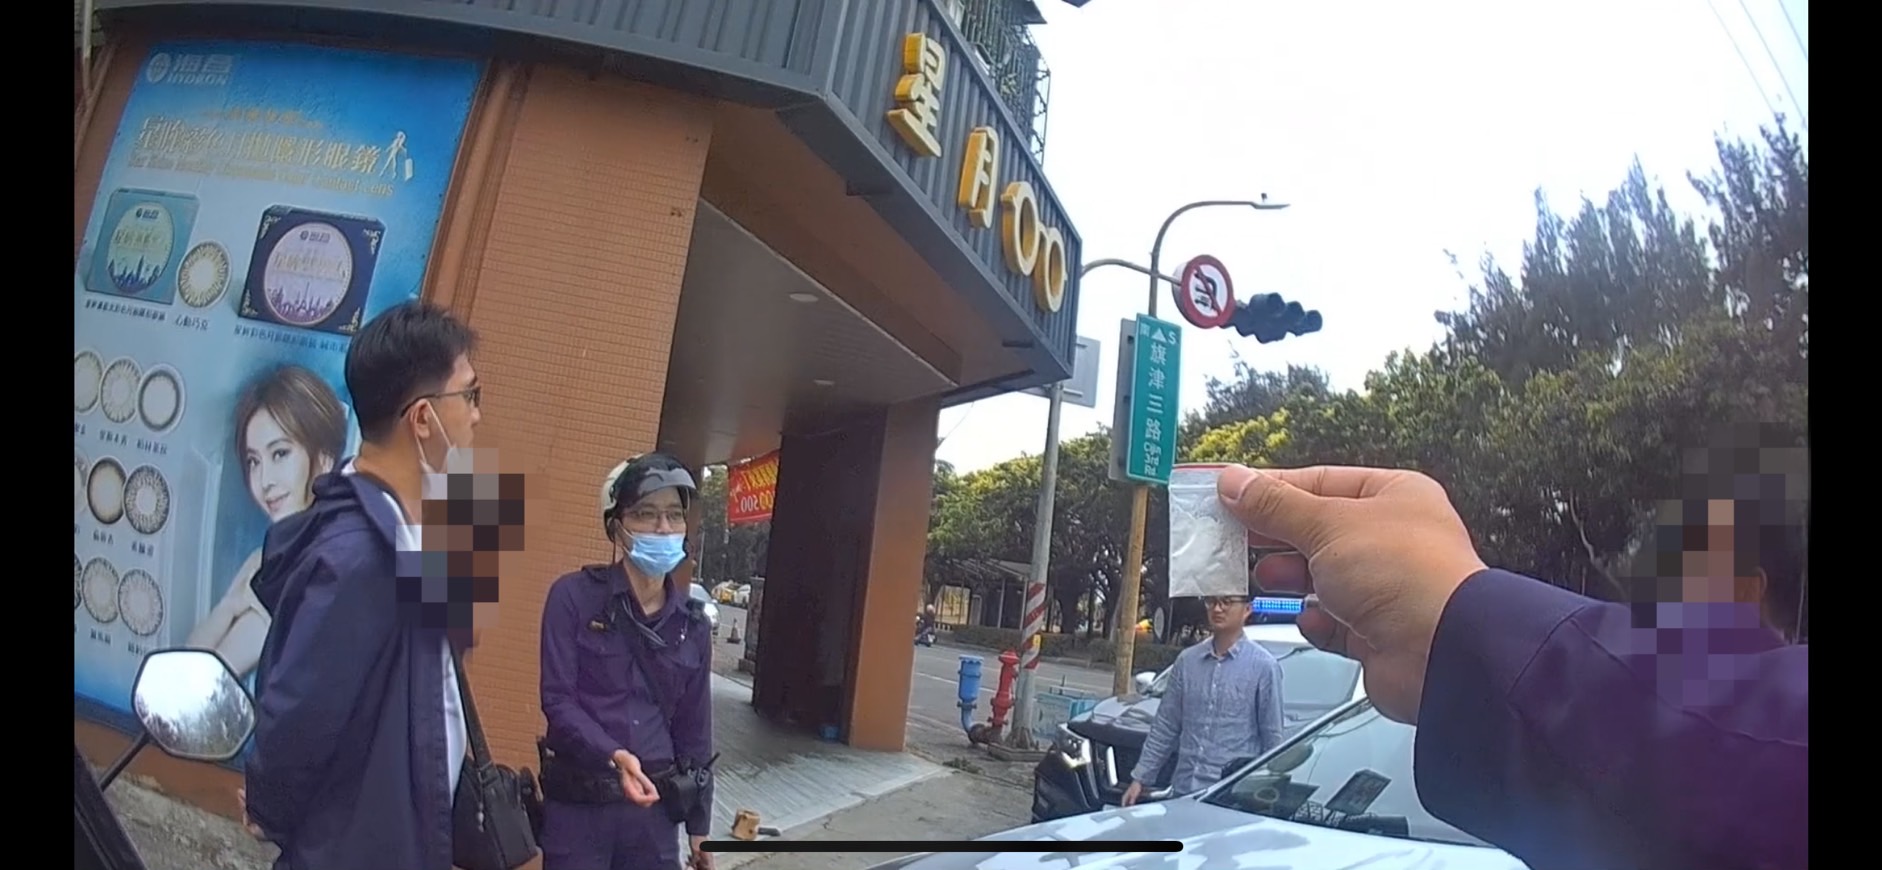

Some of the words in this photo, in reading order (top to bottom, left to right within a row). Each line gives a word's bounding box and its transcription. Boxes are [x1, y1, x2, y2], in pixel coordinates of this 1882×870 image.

[173, 53, 233, 72] 海昌
[1168, 330, 1177, 345] S
[1143, 341, 1168, 442] 旗津三路
[1144, 452, 1160, 467] 3rd
